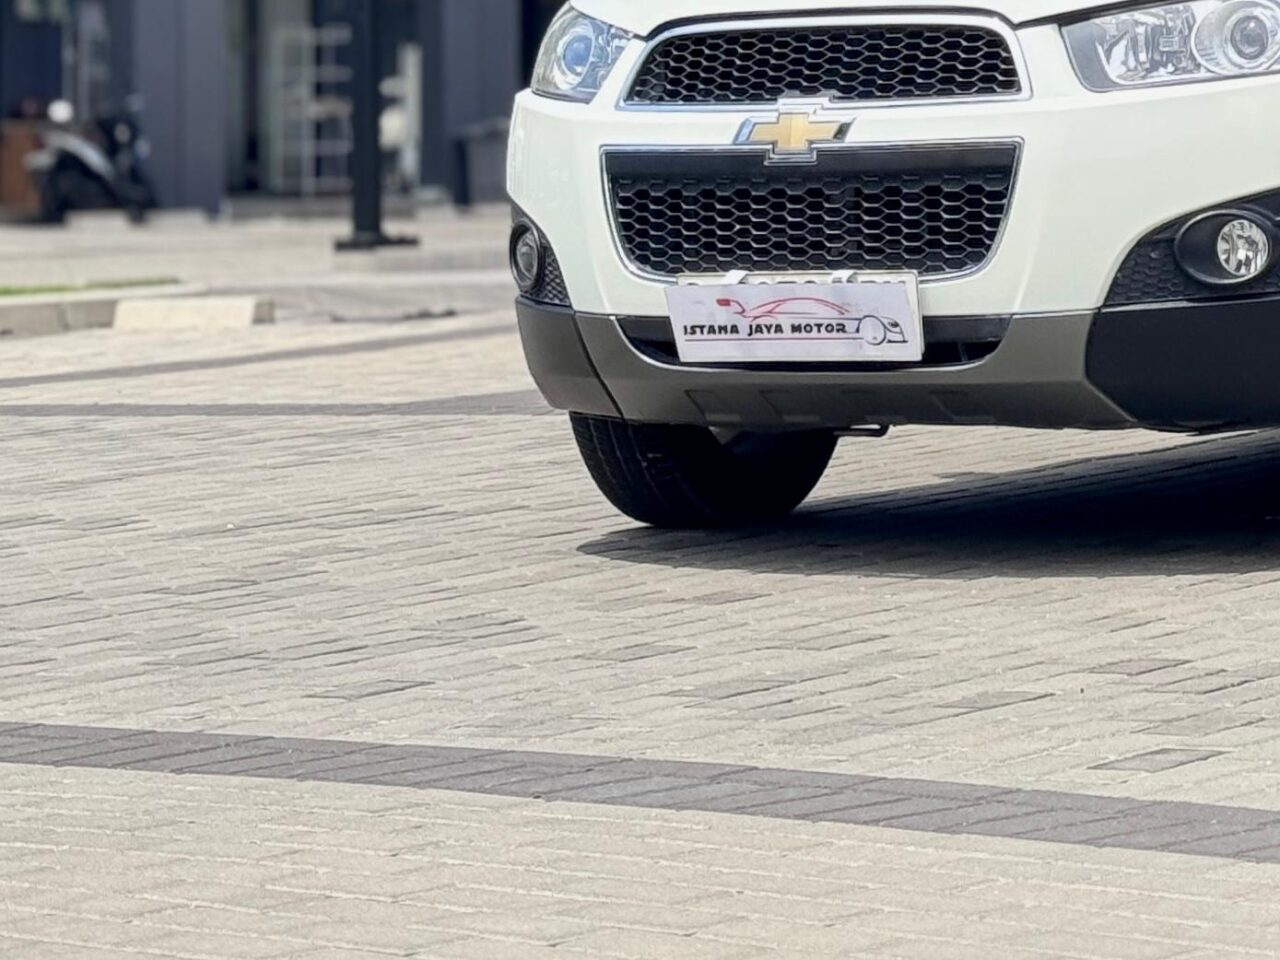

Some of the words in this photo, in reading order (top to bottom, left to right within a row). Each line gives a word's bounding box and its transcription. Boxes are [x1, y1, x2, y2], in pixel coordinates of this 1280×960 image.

[684, 324, 739, 336] ISTANA
[748, 323, 783, 336] JAYA
[791, 323, 847, 334] MOTOR
